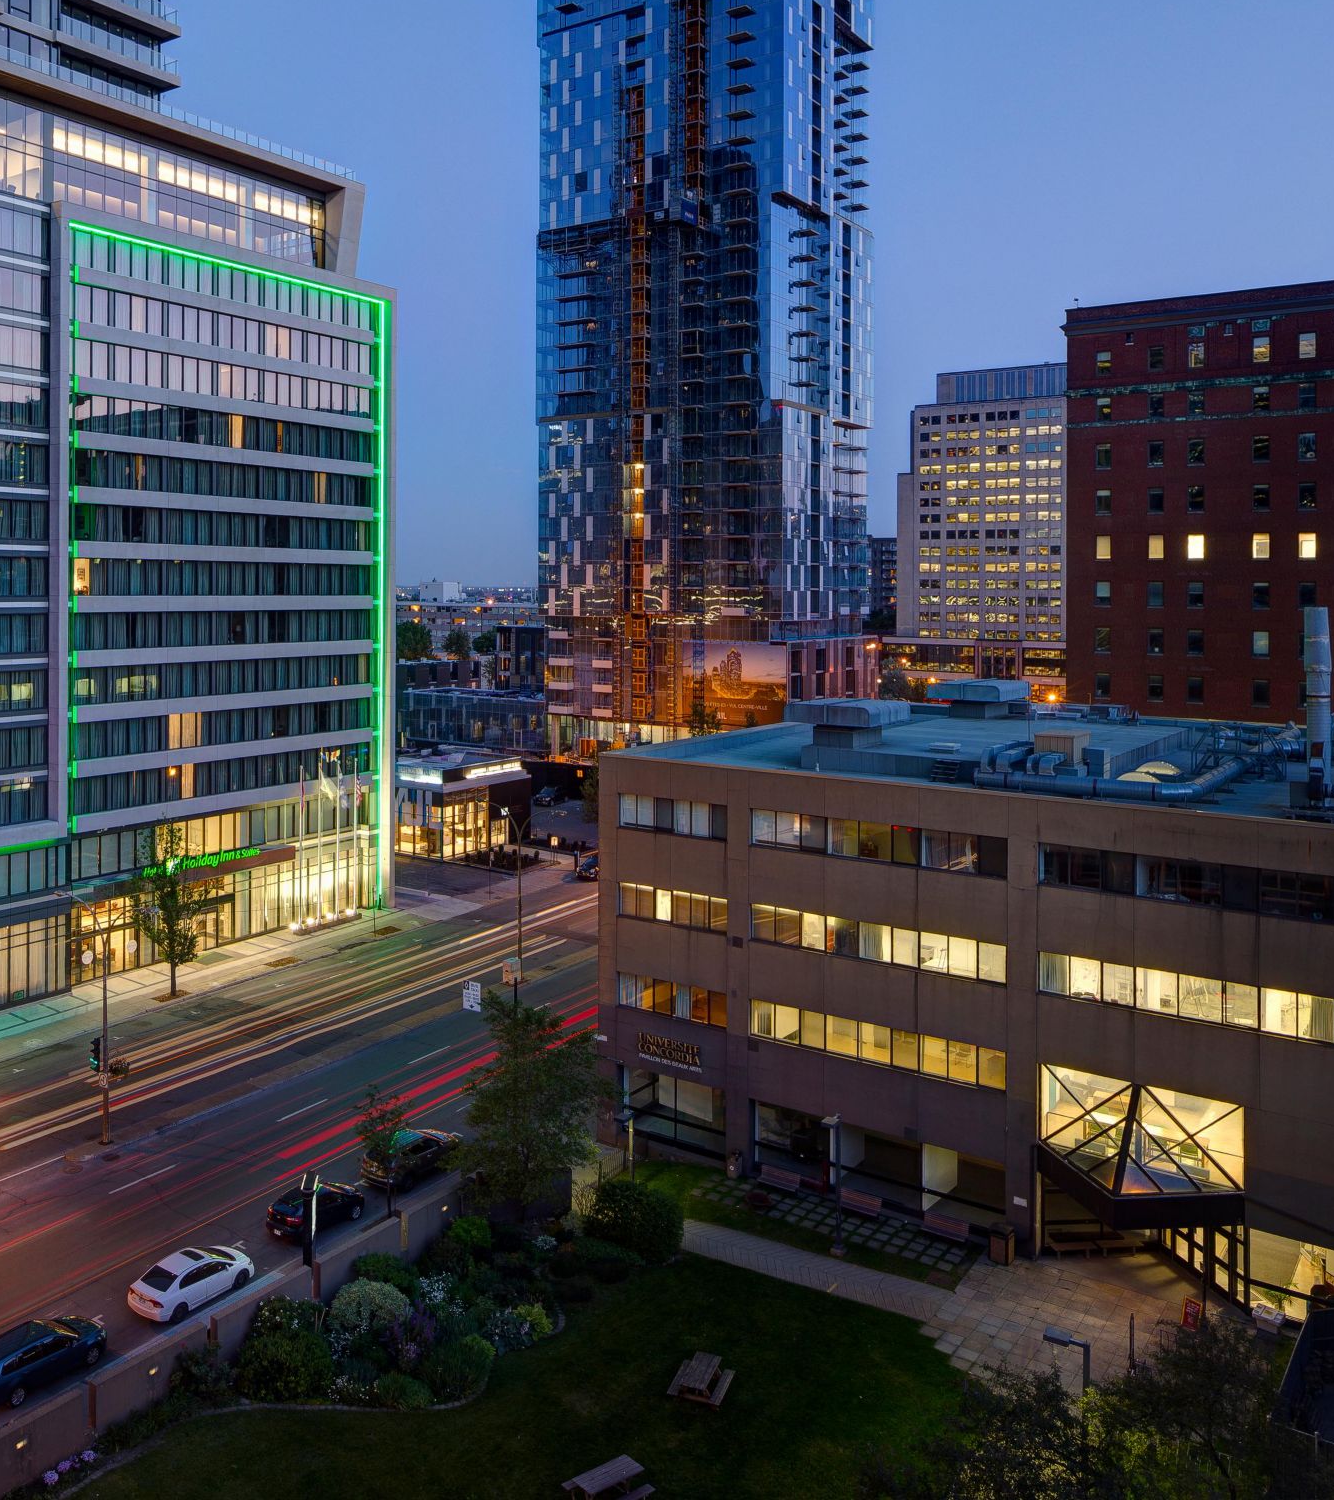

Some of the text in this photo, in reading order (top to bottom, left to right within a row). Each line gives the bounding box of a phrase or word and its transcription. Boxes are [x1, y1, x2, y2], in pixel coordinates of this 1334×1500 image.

[182, 853, 219, 870] Holiday
[219, 850, 235, 862] Inn
[638, 1042, 701, 1066] CONCORDIA
[638, 1053, 661, 1063] PAVILLON
